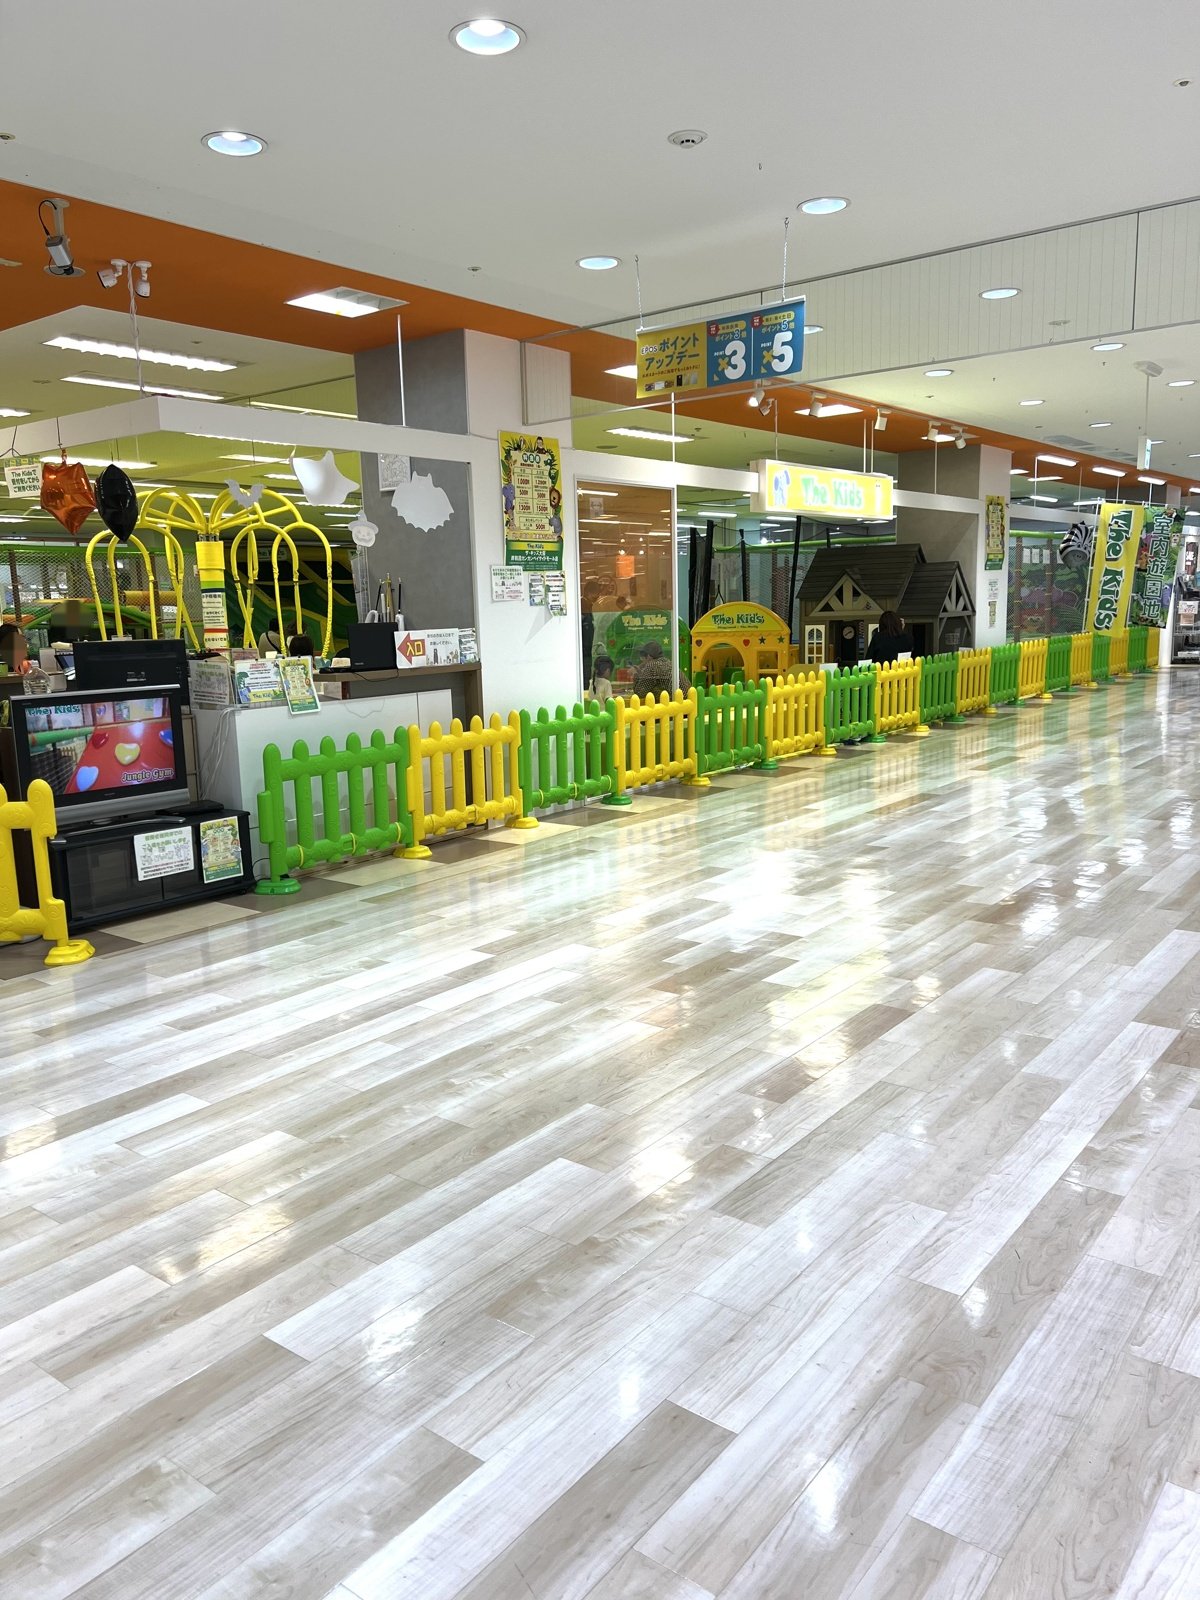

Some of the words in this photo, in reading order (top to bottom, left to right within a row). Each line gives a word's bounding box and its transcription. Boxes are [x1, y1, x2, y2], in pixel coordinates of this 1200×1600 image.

[641, 345, 658, 355] EPOS
[659, 332, 699, 353] ポイント
[645, 349, 700, 371] アップデー
[801, 477, 828, 504] The
[832, 479, 862, 507] Kids
[1105, 508, 1133, 562] The
[1142, 513, 1174, 619] 室内遊園地
[1093, 566, 1125, 631] Kids
[711, 613, 734, 625] The
[406, 641, 423, 657] 入口
[121, 769, 150, 783] Jungle
[150, 767, 174, 781] Gym
